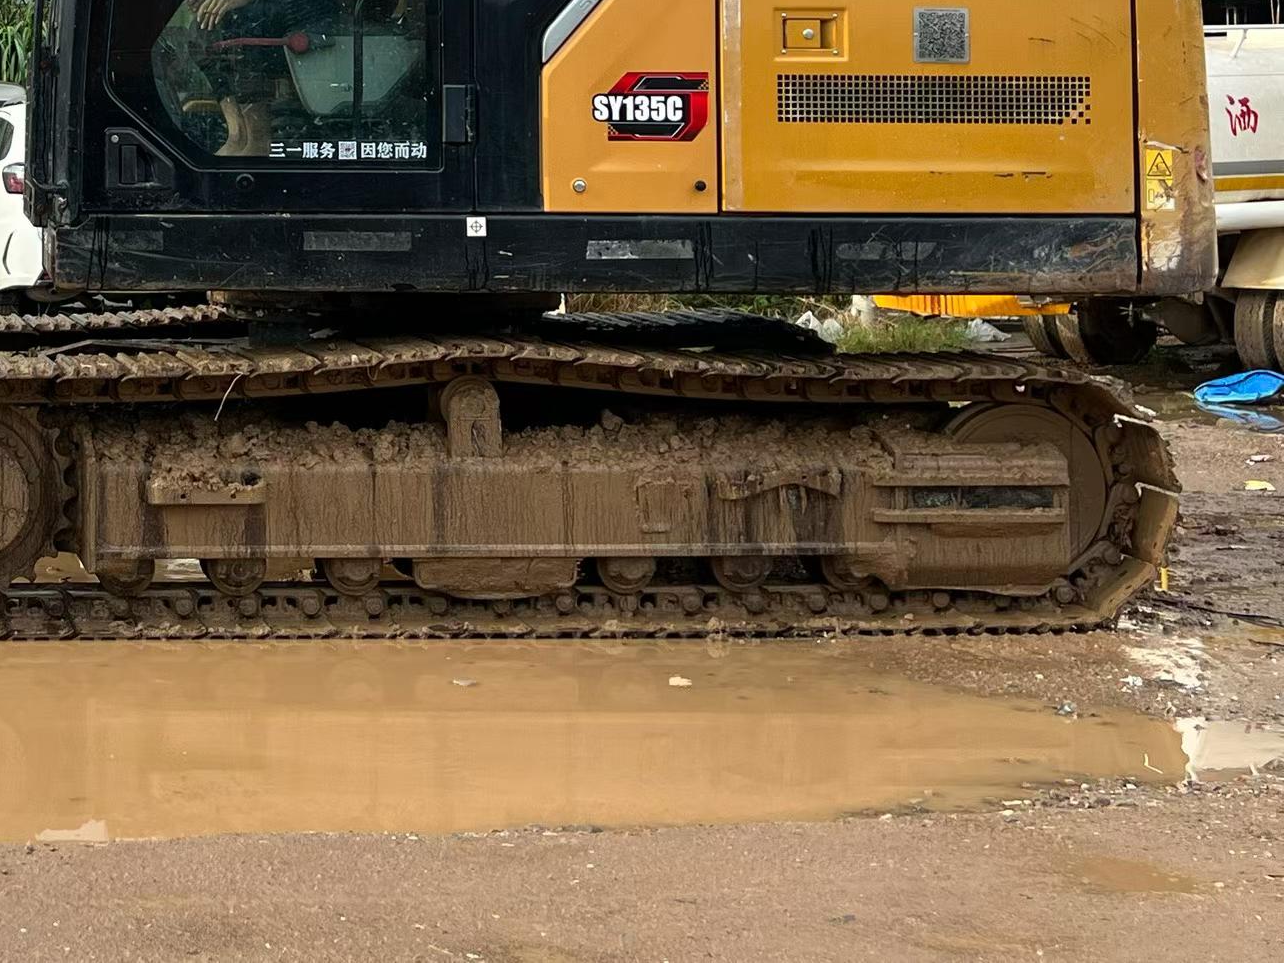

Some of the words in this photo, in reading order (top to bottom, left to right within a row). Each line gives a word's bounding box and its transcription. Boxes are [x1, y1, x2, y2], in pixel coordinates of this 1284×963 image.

[593, 95, 683, 121] SY135C
[269, 142, 335, 159] 三一服务
[360, 141, 427, 159] 因您而动
